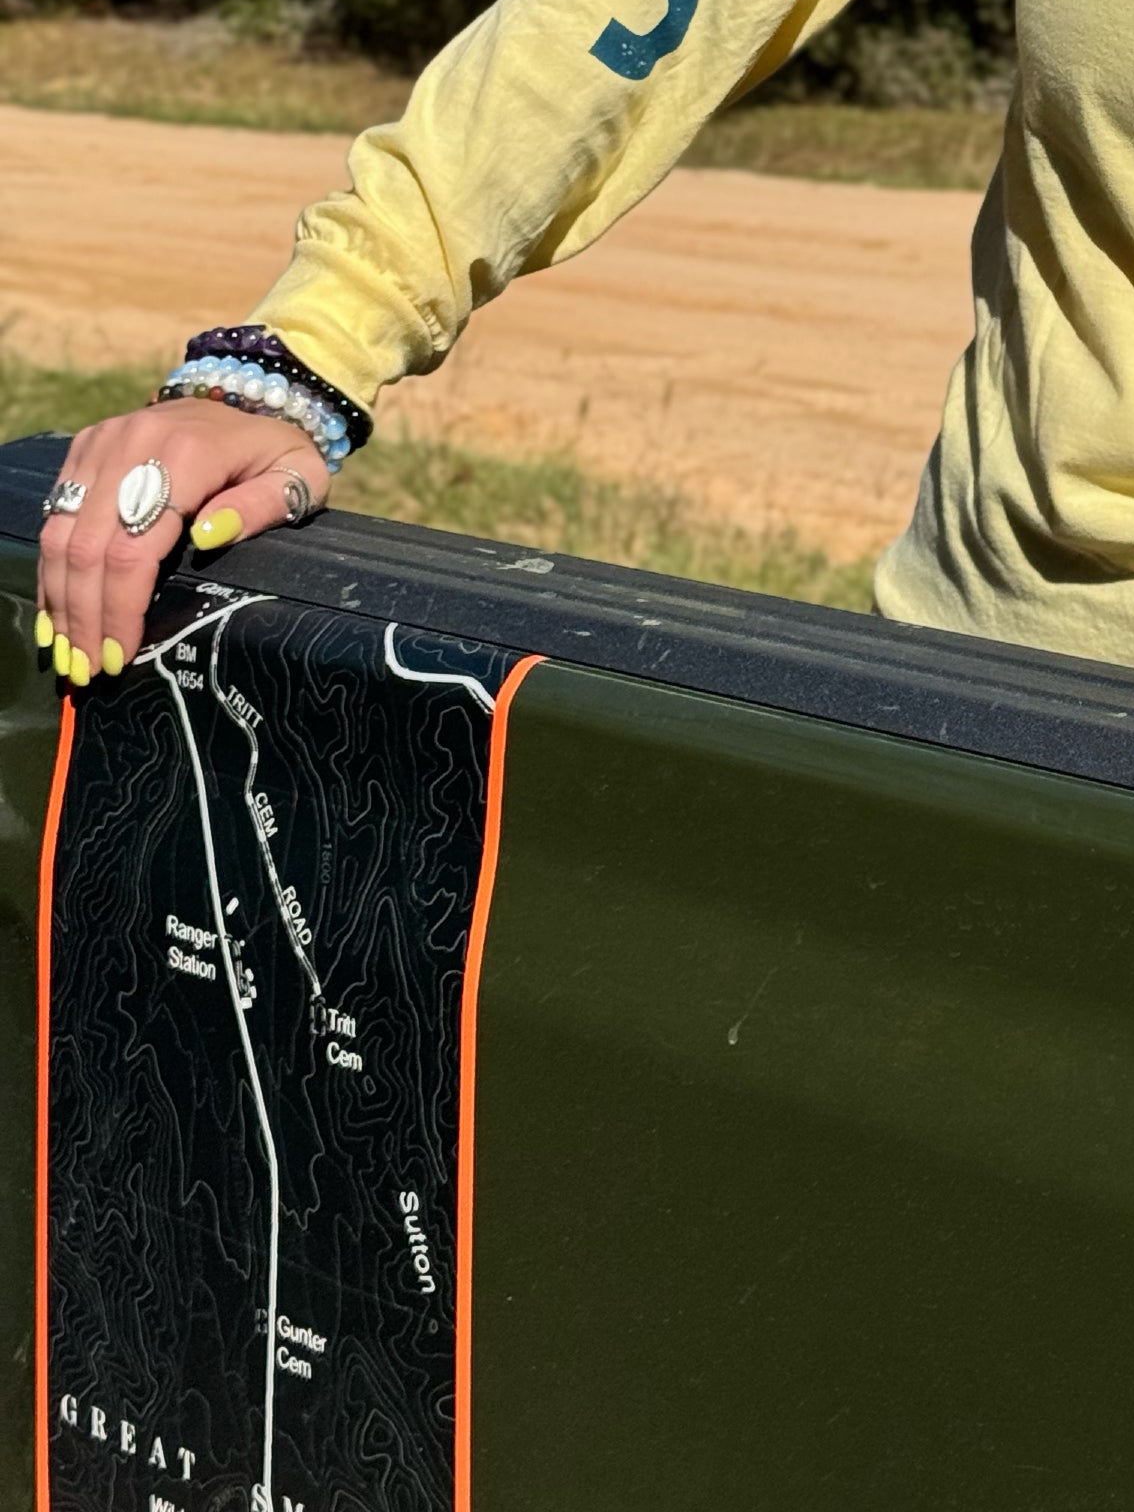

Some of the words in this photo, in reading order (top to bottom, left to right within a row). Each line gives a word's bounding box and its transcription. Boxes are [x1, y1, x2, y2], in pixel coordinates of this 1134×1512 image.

[175, 642, 198, 663] BM
[175, 668, 204, 691] 1654
[225, 684, 263, 729] TRITT
[254, 792, 279, 838] CEM
[282, 885, 313, 946] ROAD
[320, 842, 333, 884] 1800
[165, 914, 218, 950] Ranger
[167, 945, 217, 981] Station
[327, 1008, 357, 1038] Tritt
[326, 1041, 363, 1072] Cem
[399, 1191, 436, 1294] Sutton
[276, 1315, 327, 1353] Gunter
[276, 1346, 312, 1379] Cem
[60, 1393, 196, 1480] GREAT
